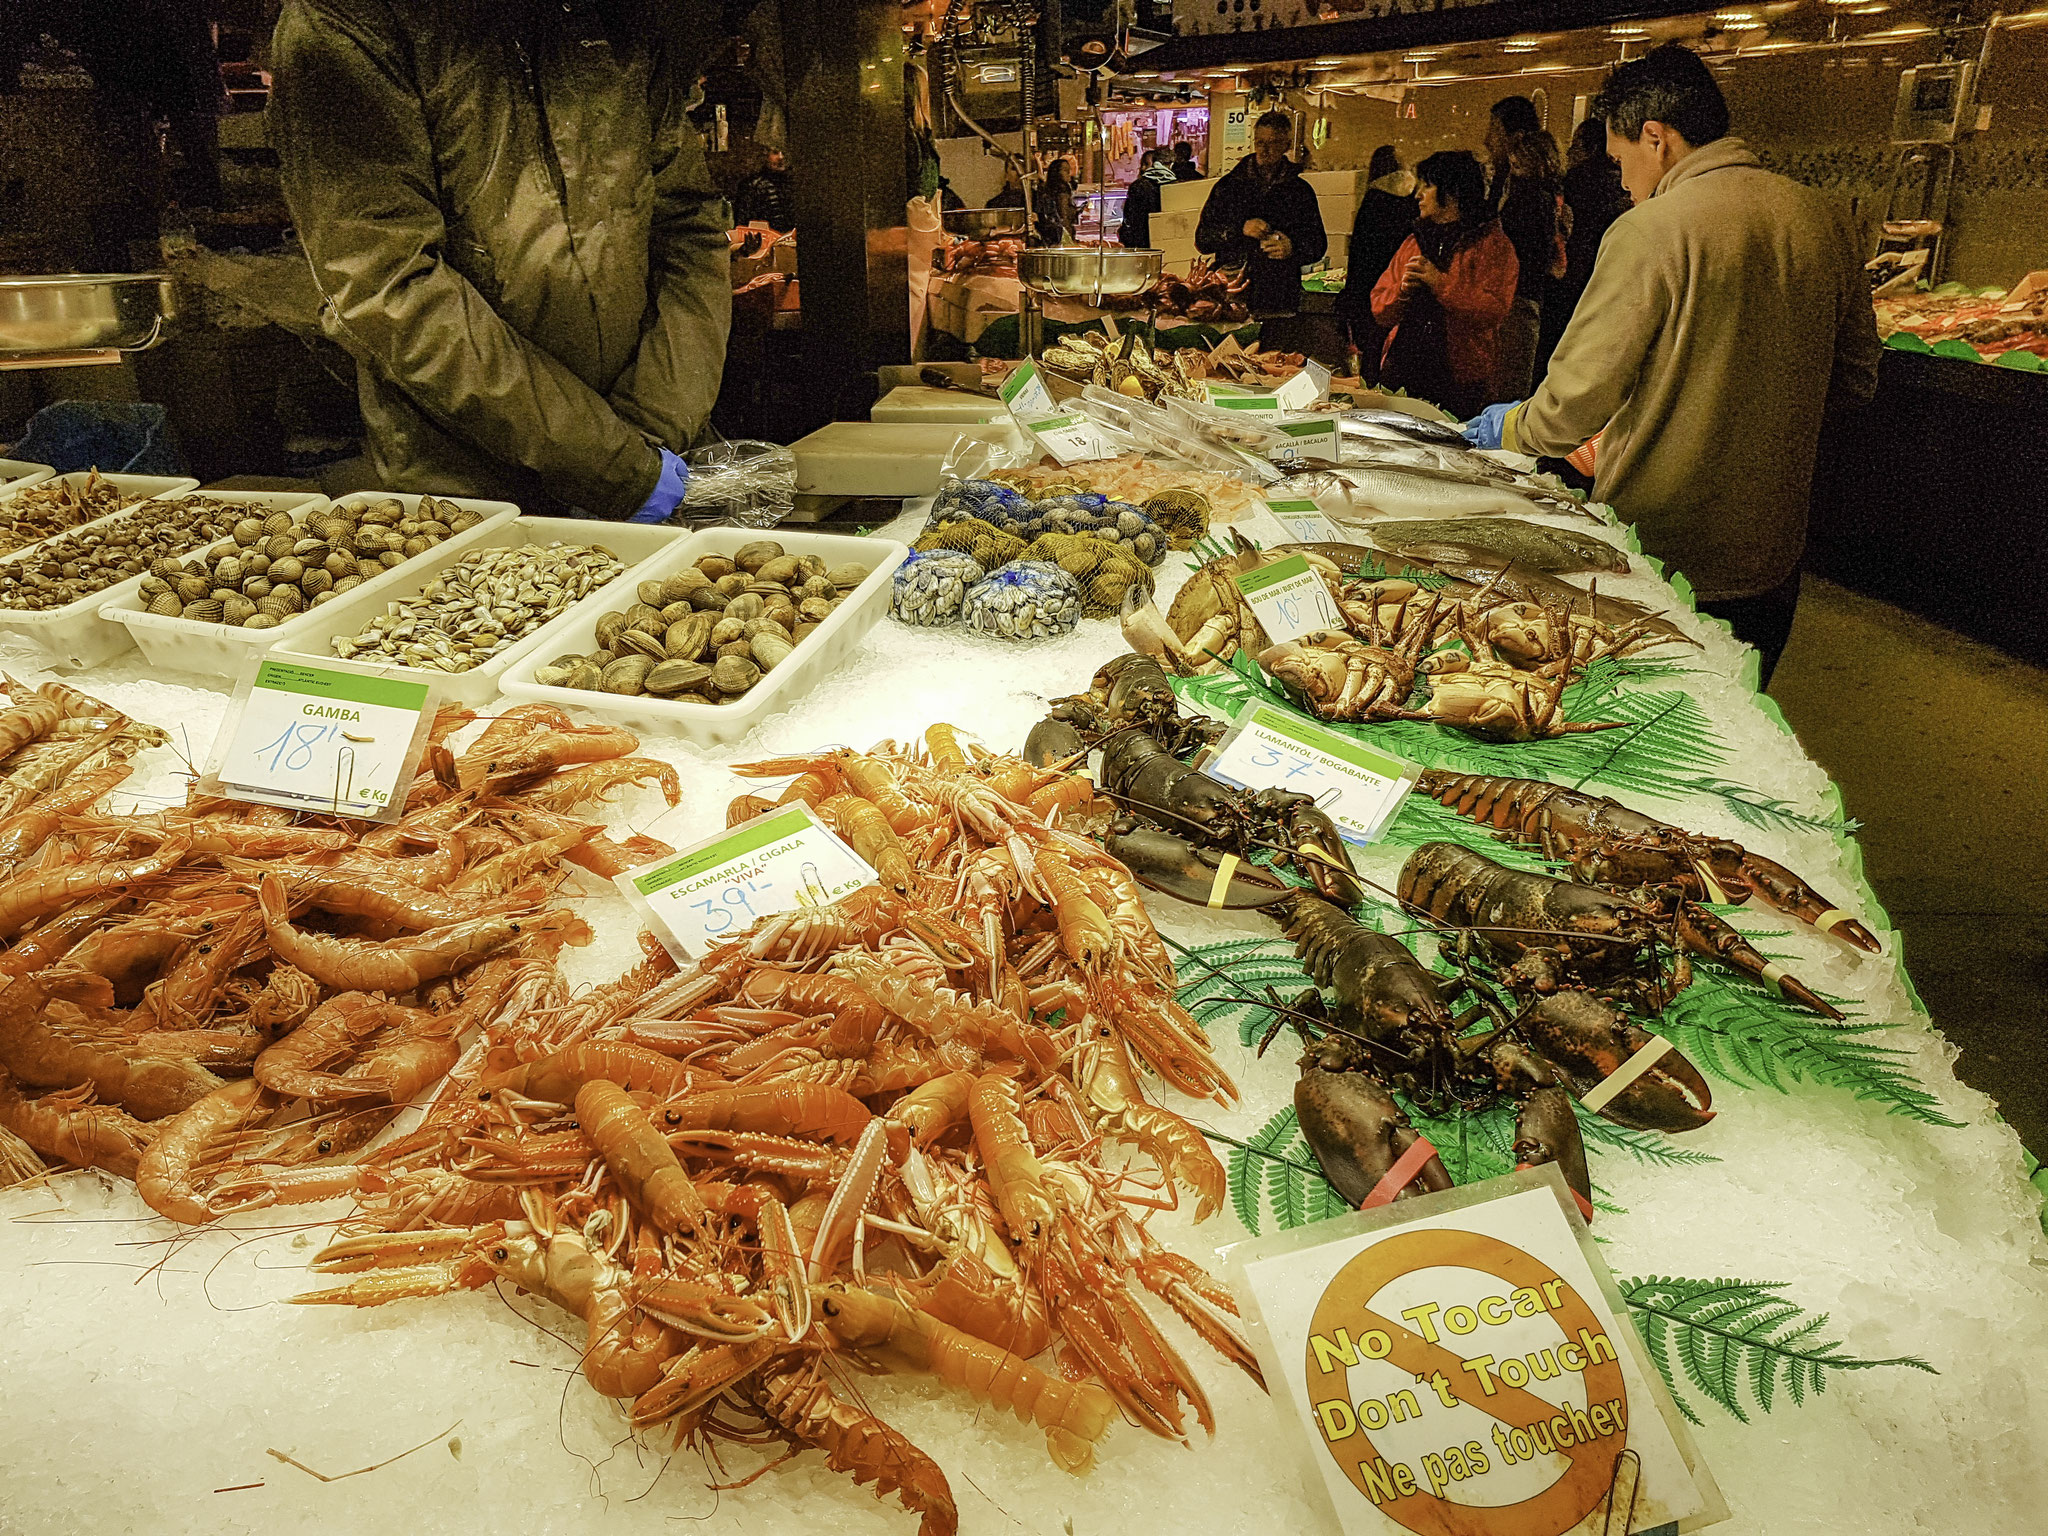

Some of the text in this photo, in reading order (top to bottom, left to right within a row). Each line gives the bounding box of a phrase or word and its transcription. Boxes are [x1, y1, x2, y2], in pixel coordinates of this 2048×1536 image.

[1228, 112, 1245, 124] 50
[1261, 592, 1270, 601] DE
[1294, 579, 1303, 588] DE
[302, 703, 361, 722] GAMBA
[1254, 730, 1312, 759] LLAMANTÓL
[1319, 757, 1382, 787] BOGABANTE
[359, 788, 388, 804] € Kg
[1339, 816, 1365, 830] € Kg
[758, 839, 806, 862] CIGALA
[832, 879, 862, 895] € Kg
[1310, 1277, 1567, 1375] No Tocar
[1462, 1326, 1620, 1398] Touch
[1358, 1396, 1628, 1506] Ne pas toucher
